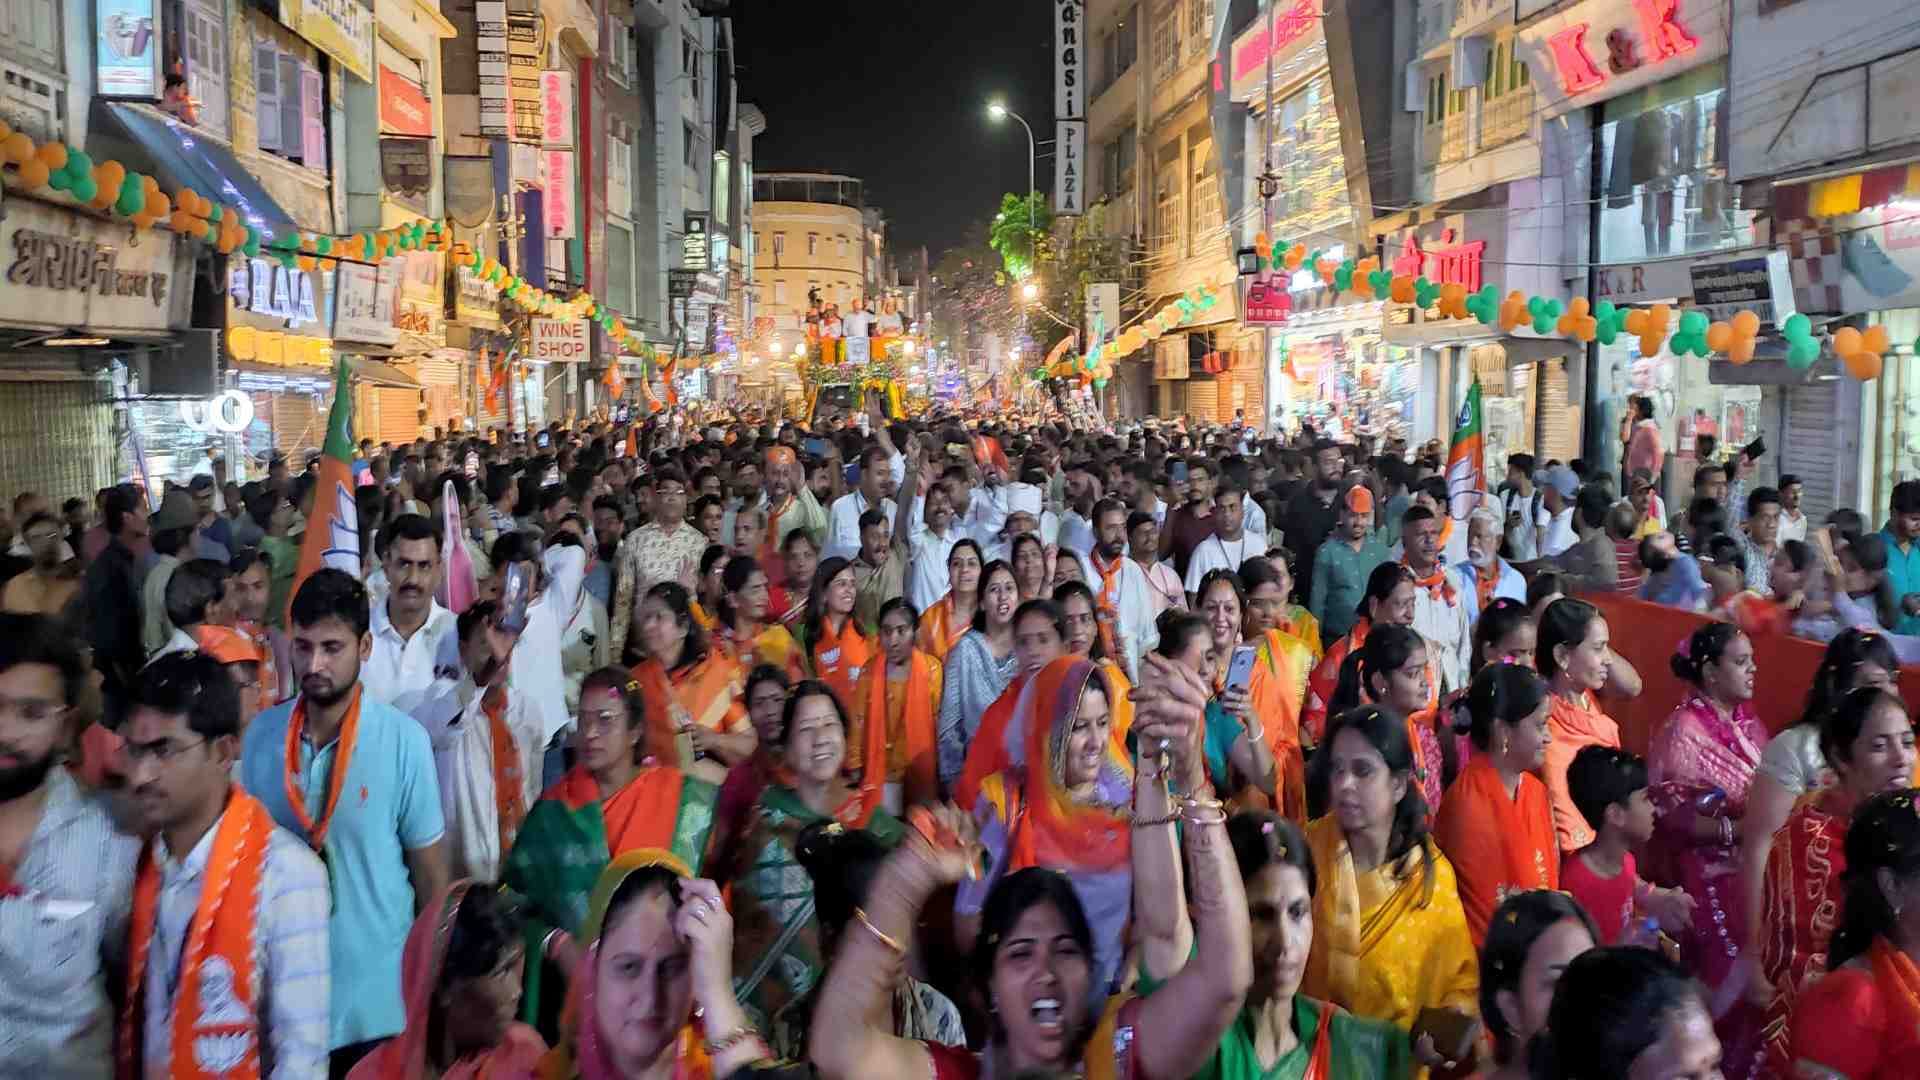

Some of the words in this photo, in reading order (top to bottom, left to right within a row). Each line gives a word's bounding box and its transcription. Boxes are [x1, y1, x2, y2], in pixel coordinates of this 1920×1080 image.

[1063, 128, 1076, 209] PLAZA
[540, 322, 584, 338] WINE
[537, 342, 584, 357] SHOP
